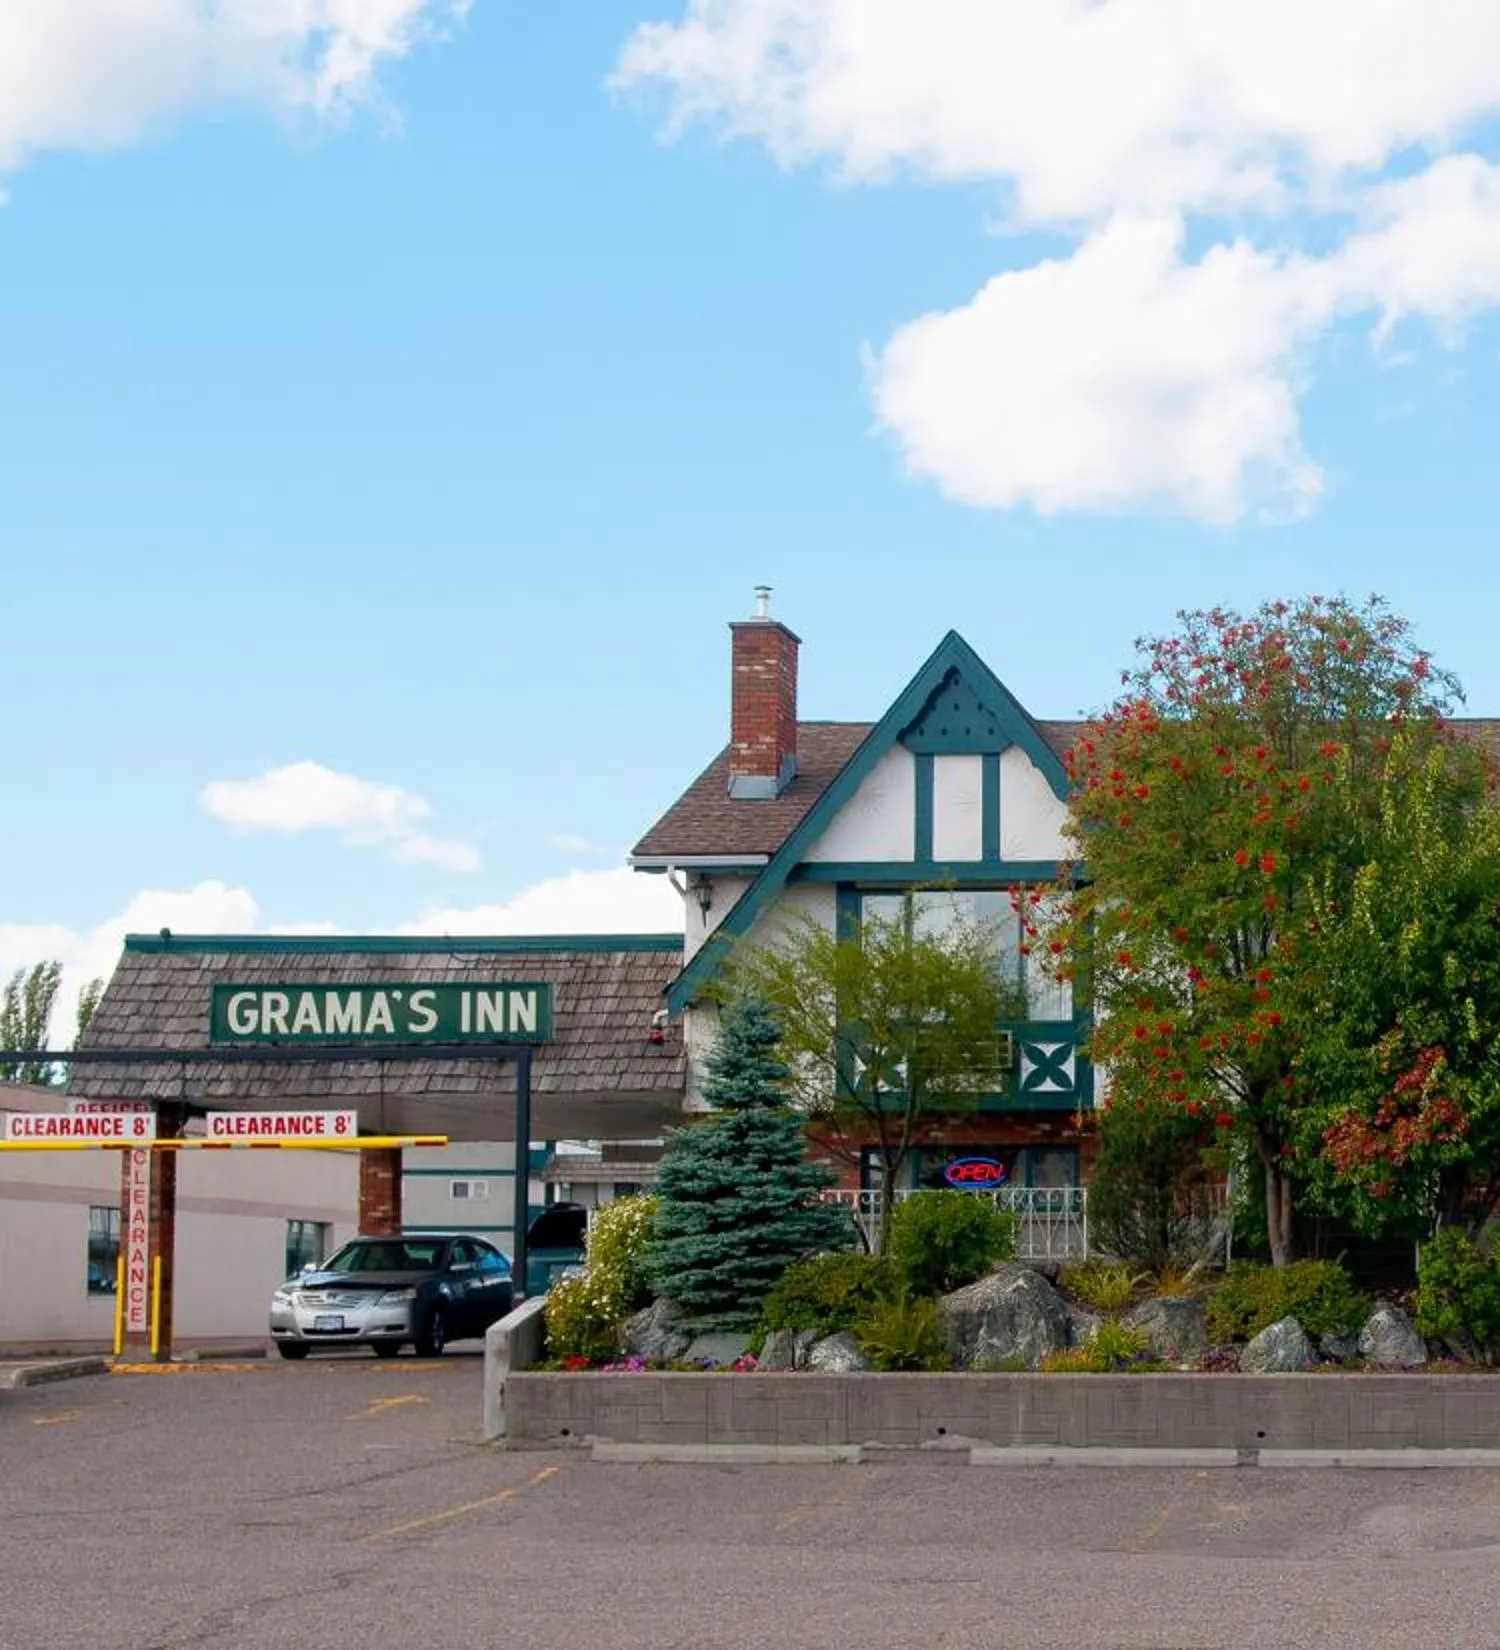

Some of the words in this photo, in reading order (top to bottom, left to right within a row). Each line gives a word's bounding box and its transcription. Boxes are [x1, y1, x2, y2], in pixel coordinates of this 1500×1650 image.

[227, 989, 439, 1035] GRAMA'S
[461, 991, 537, 1033] INN
[11, 1117, 124, 1137] CLEARANCE
[132, 1116, 151, 1137] 8'
[213, 1116, 325, 1135] CLEARANCE
[335, 1115, 351, 1135] 8'
[946, 1163, 1004, 1182] OPEN
[130, 1150, 146, 1322] CLEARANCE
